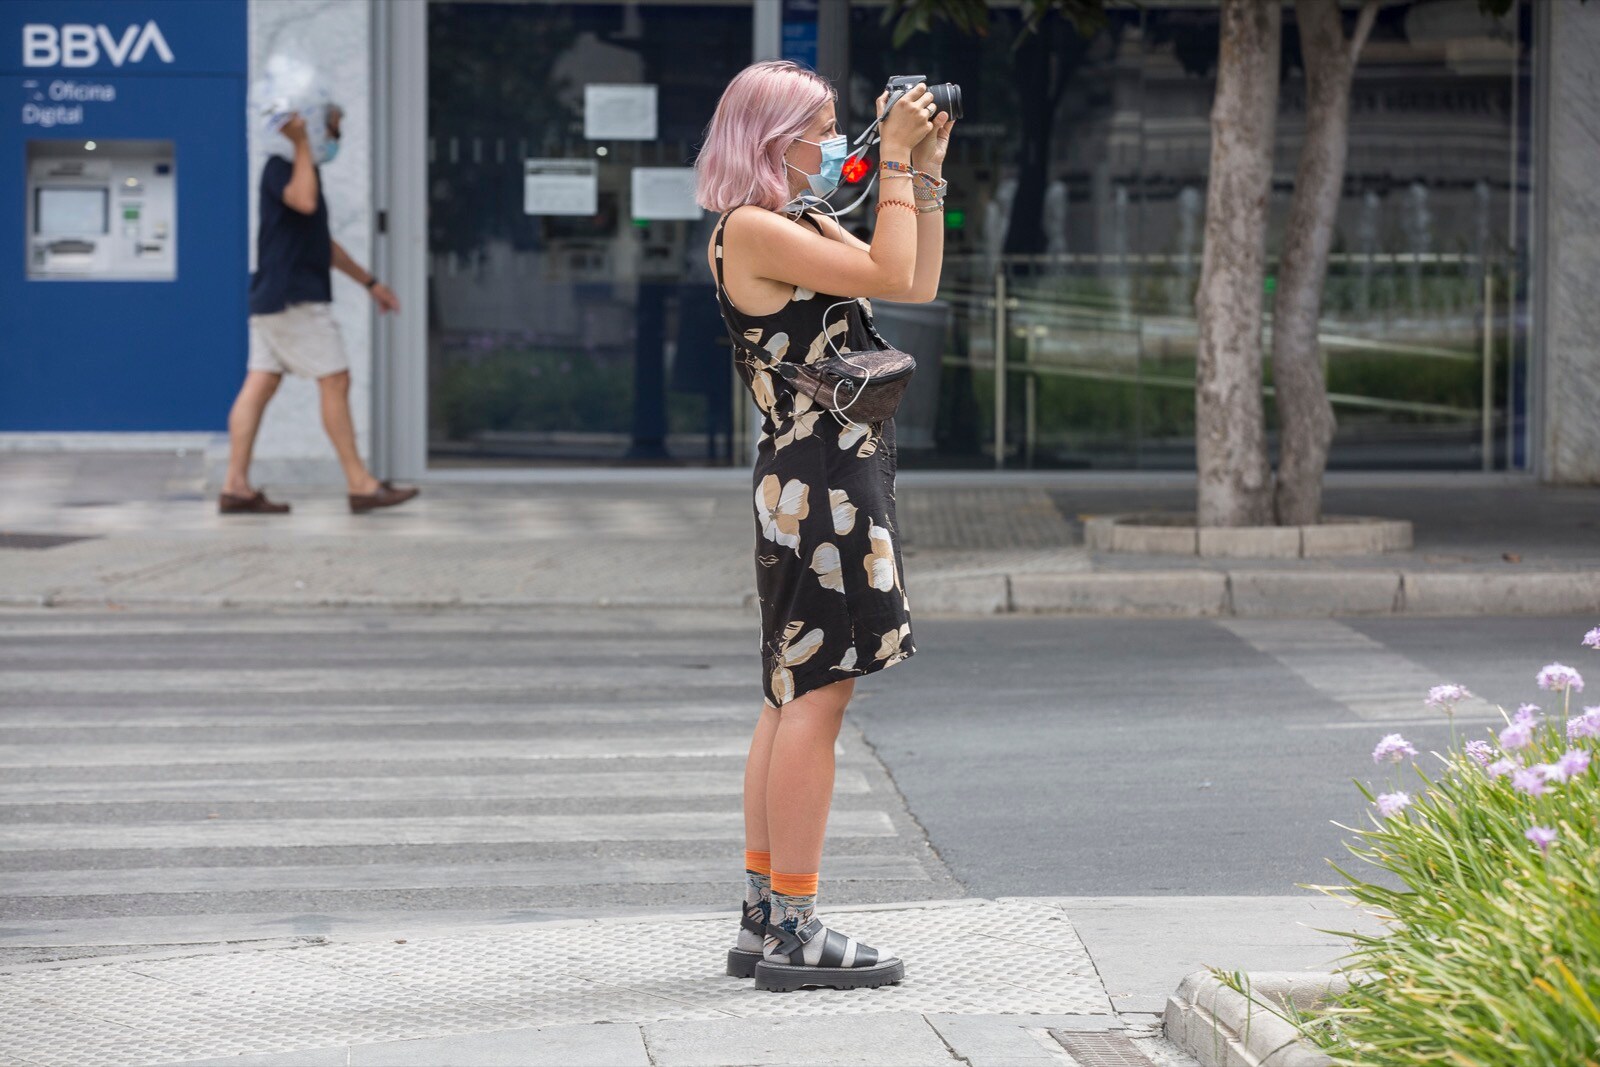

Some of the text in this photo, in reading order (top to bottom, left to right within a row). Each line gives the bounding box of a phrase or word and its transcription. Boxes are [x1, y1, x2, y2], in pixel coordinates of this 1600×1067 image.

[22, 20, 175, 68] BBVA
[49, 79, 116, 102] Oficina
[22, 104, 84, 127] Digital
